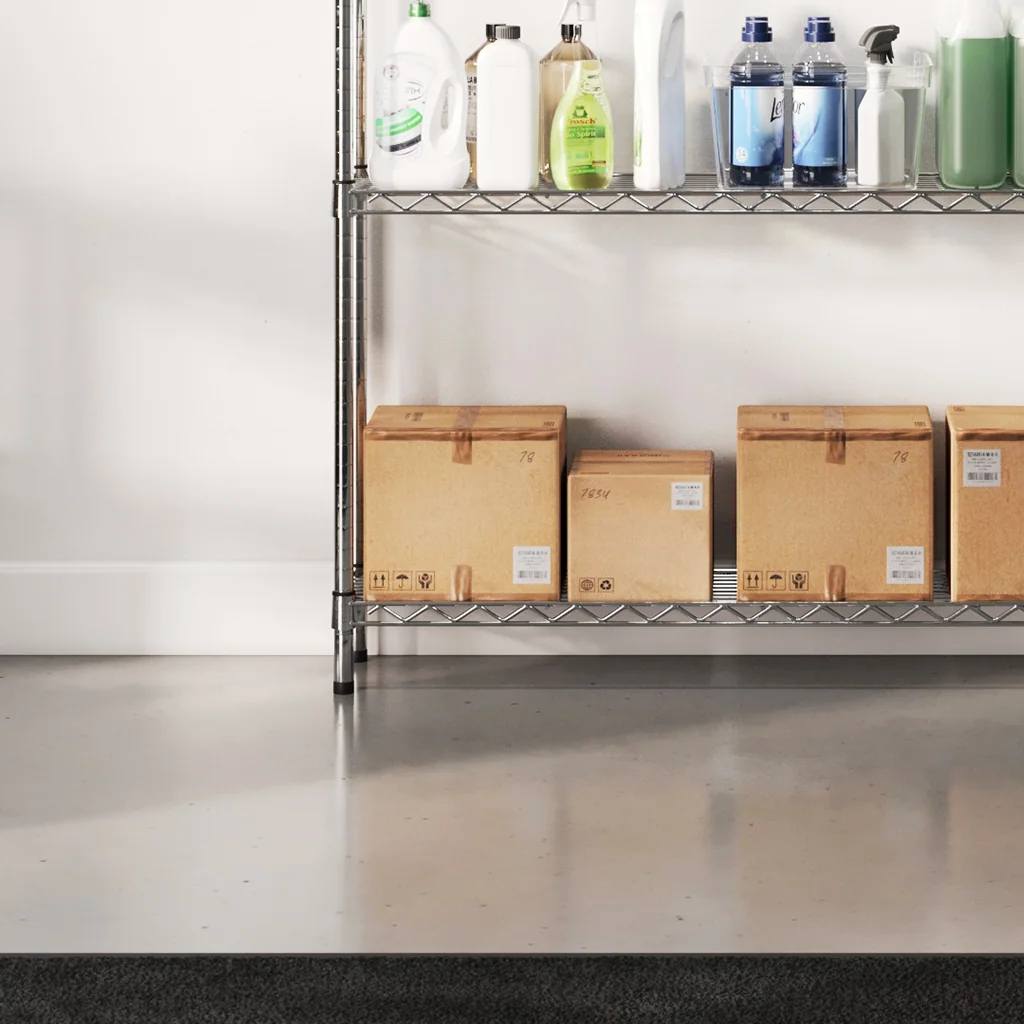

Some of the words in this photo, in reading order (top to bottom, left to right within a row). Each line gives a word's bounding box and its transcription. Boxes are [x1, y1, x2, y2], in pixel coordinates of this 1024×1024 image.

[519, 450, 536, 463] 78
[892, 450, 909, 463] 78
[580, 487, 611, 500] 7834
